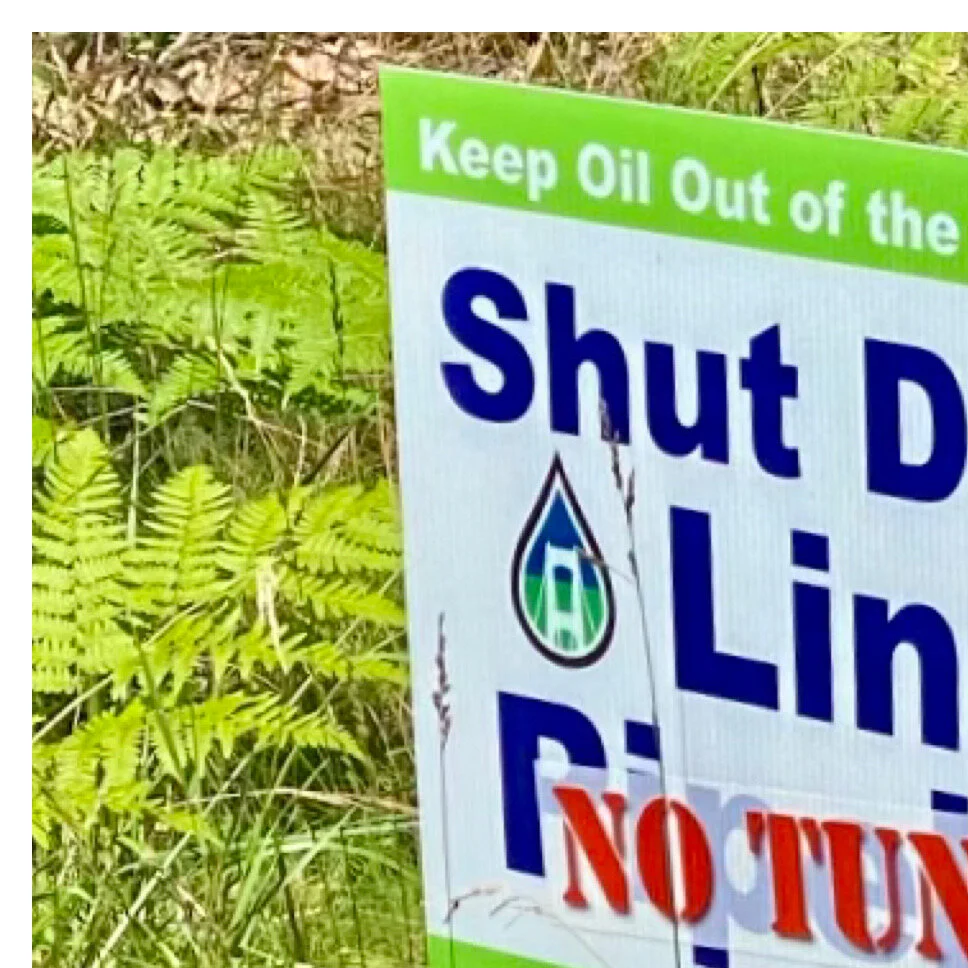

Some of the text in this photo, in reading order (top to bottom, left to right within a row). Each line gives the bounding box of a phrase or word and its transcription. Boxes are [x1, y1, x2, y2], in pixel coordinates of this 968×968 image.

[417, 117, 558, 201] Keep
[577, 141, 651, 205] Oil
[670, 157, 771, 226] Out
[788, 181, 846, 236] of
[866, 190, 960, 255] the
[440, 266, 801, 479] Shut
[552, 783, 715, 926] NO
